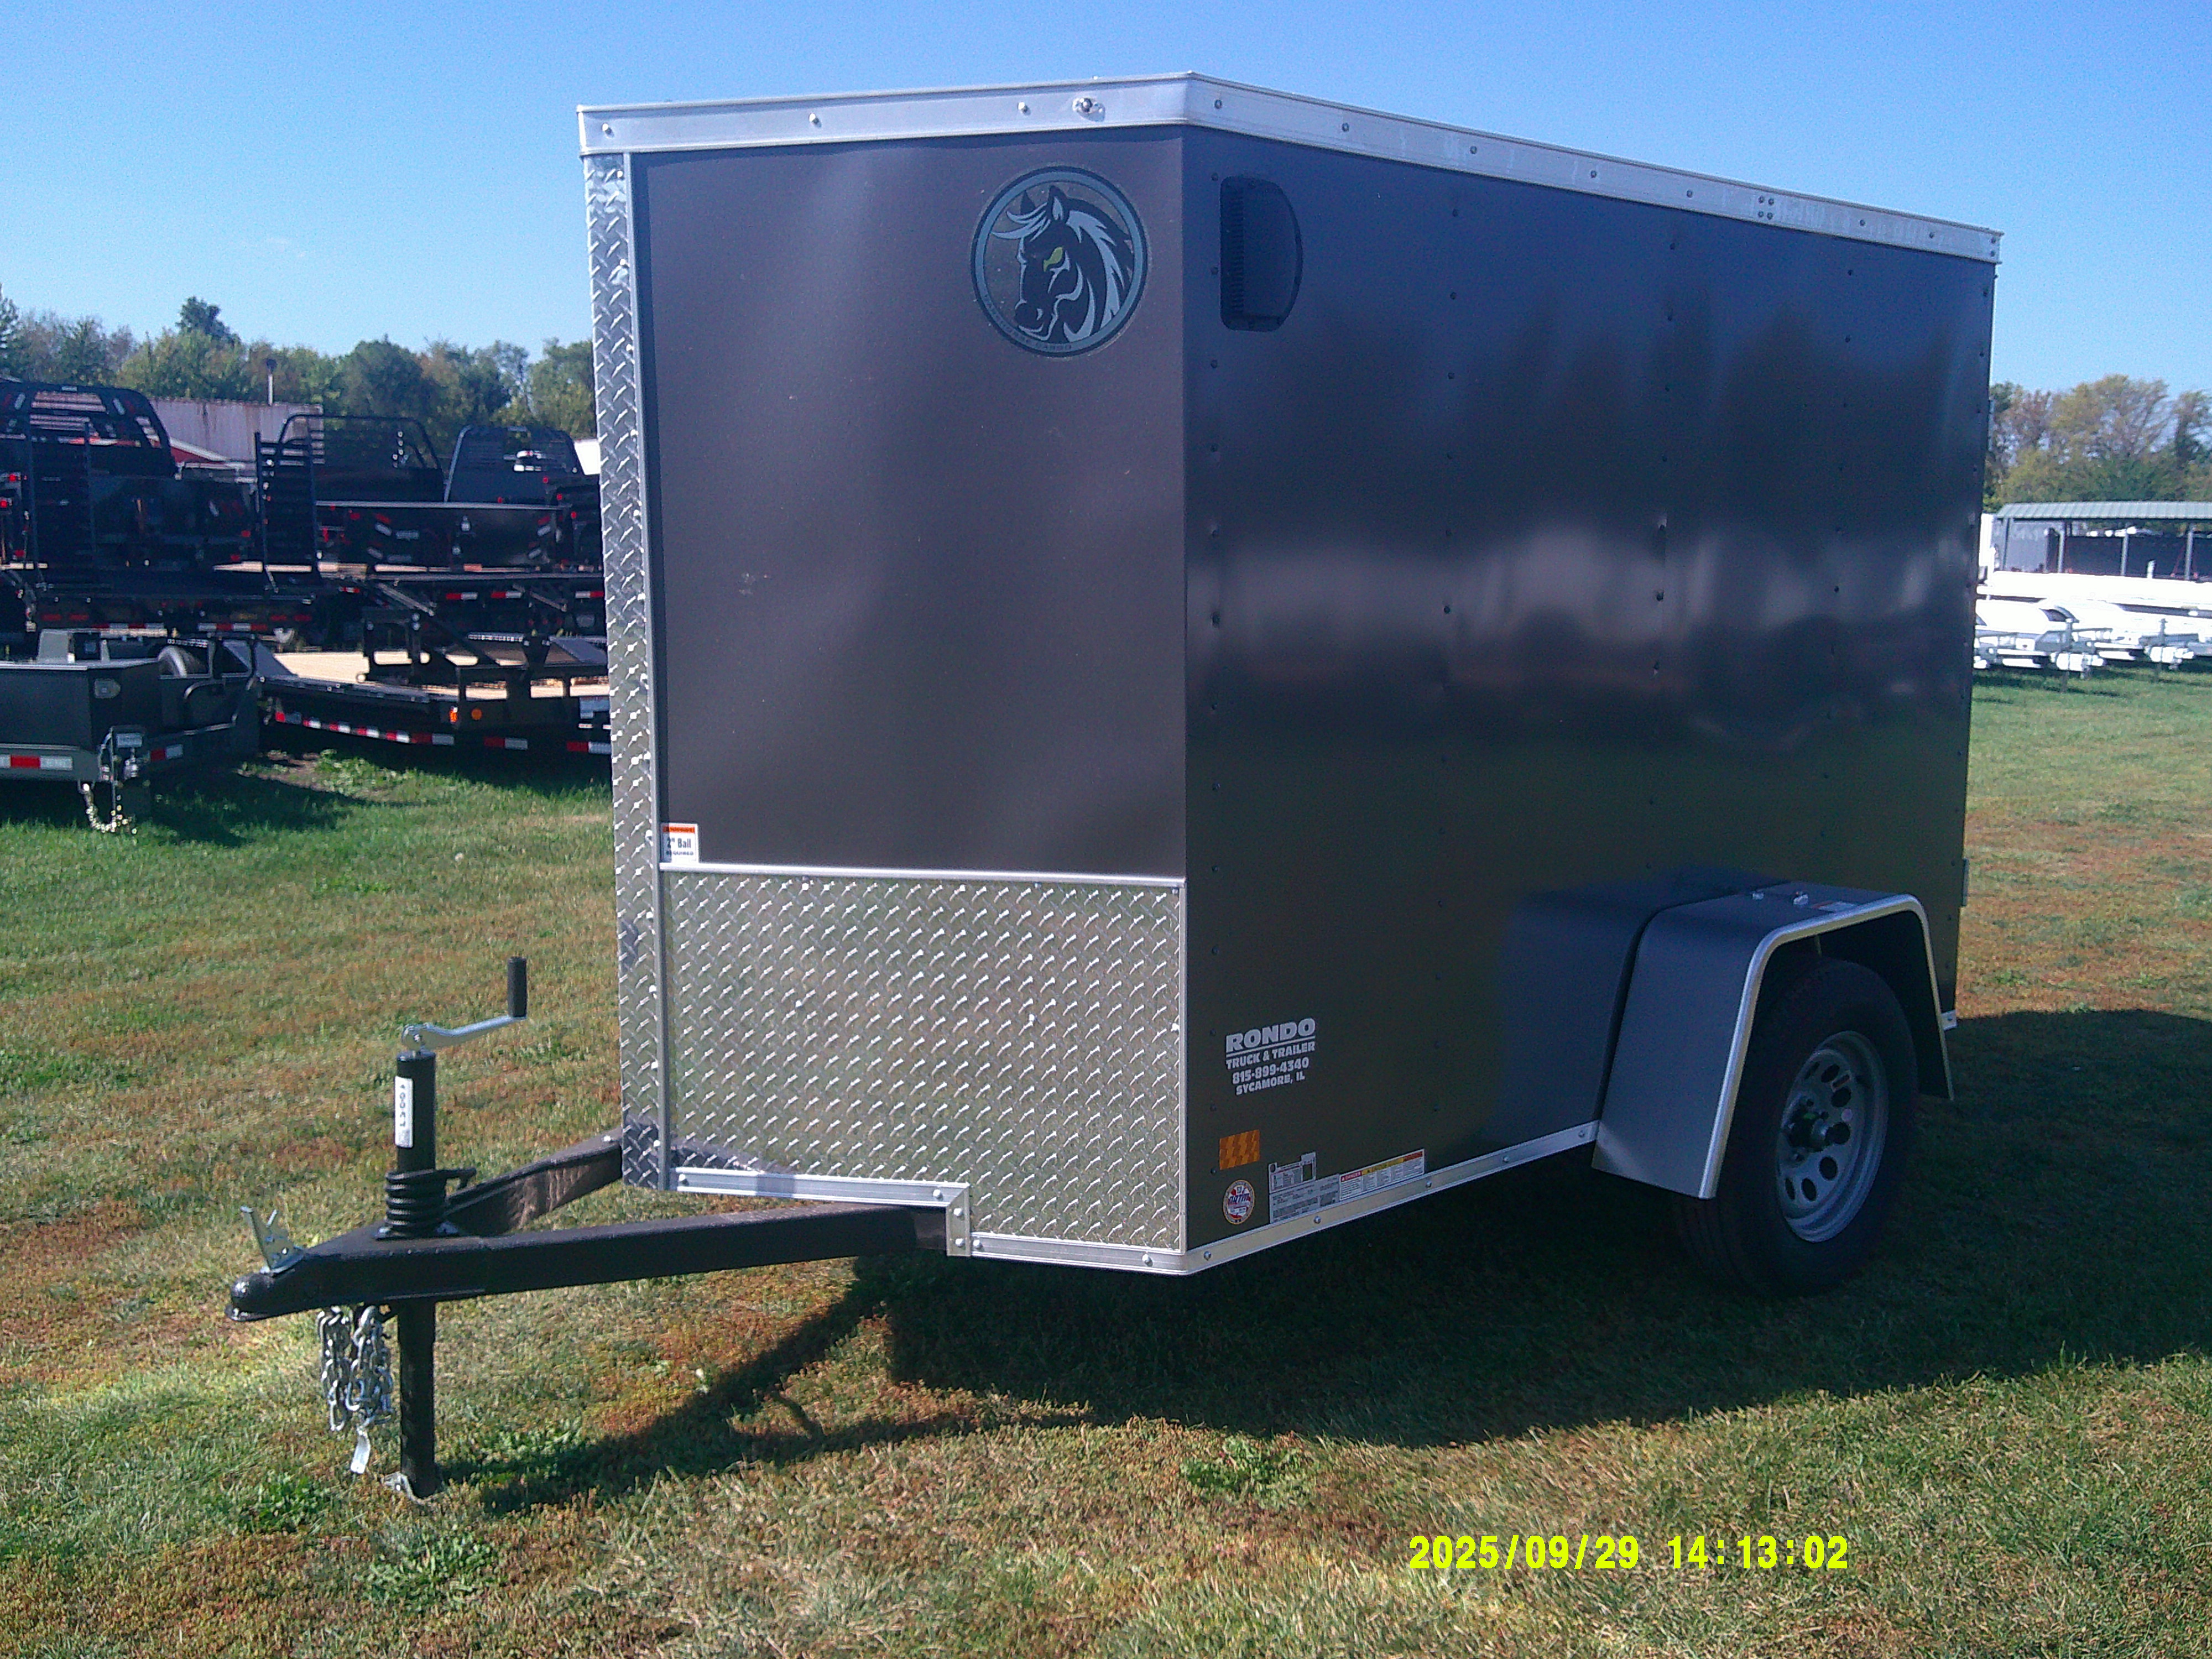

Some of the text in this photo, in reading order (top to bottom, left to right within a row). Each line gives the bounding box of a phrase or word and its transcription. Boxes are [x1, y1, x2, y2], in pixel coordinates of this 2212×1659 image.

[677, 838, 691, 848] Ball
[1226, 1018, 1316, 1053] RONDO
[1226, 1041, 1316, 1070] TRUCK & TRAILER
[1232, 1057, 1310, 1084] 815-899-4340
[1236, 1071, 1306, 1095] SYCAMORE, IL
